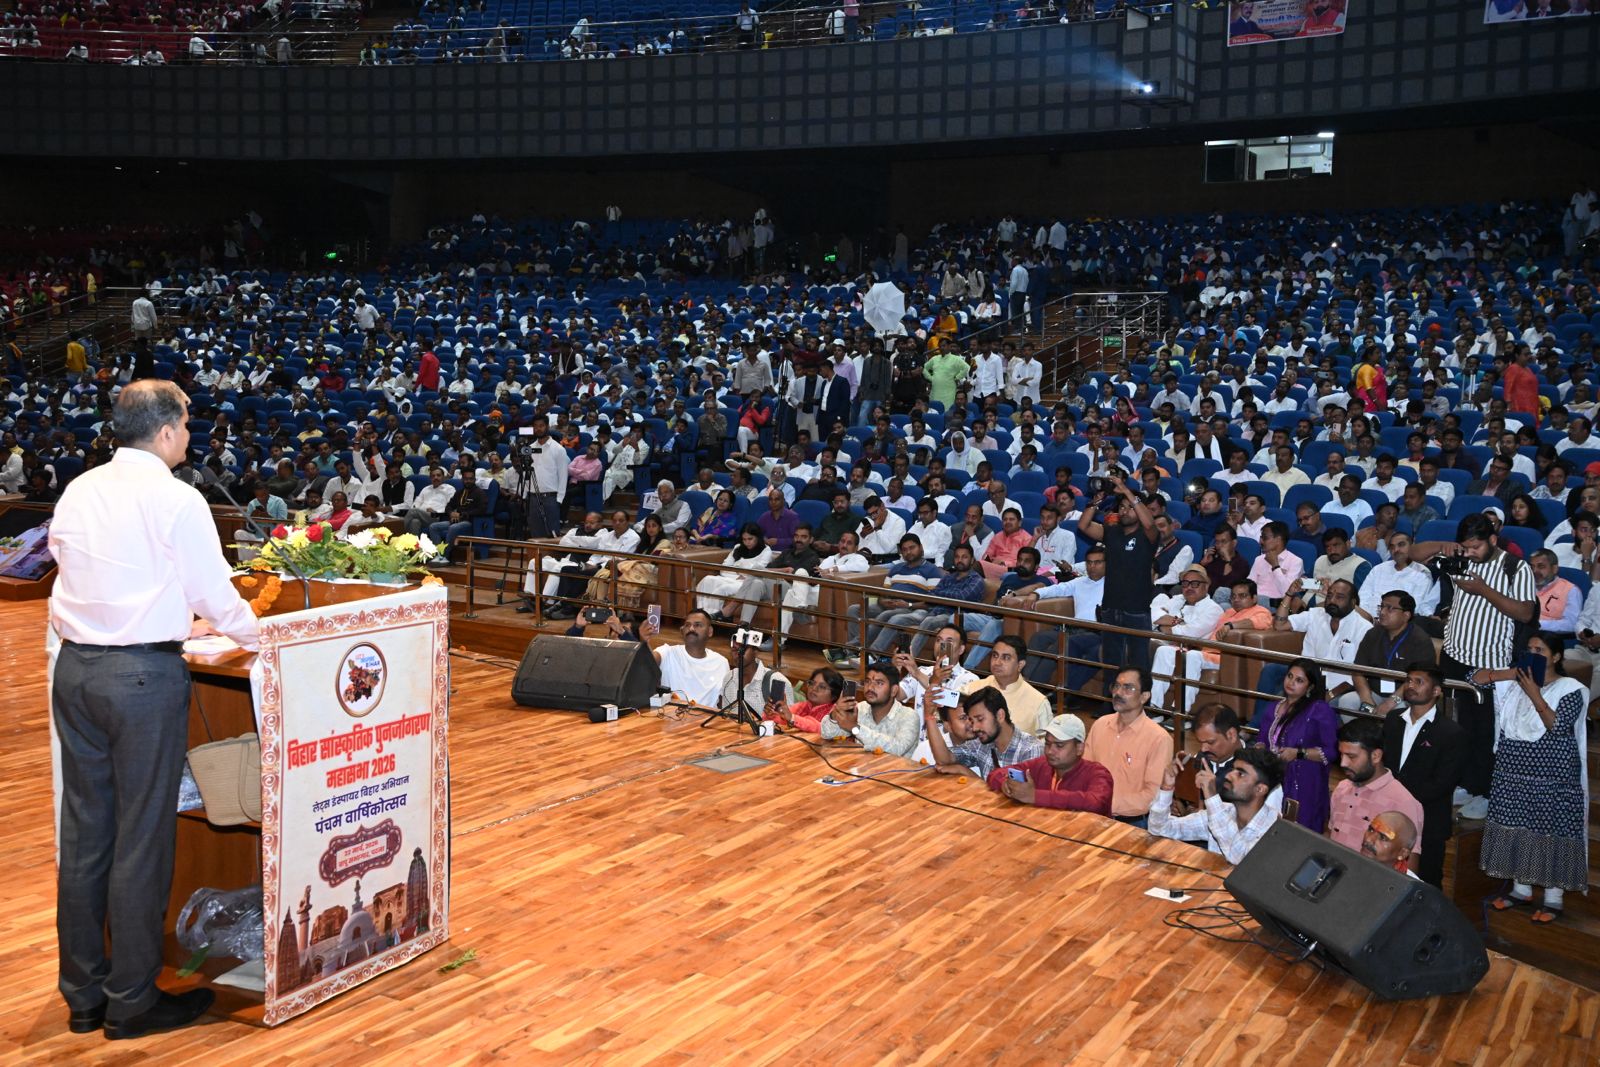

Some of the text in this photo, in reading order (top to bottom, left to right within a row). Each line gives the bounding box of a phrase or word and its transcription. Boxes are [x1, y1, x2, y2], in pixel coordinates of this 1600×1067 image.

[287, 713, 431, 770] बिहार सांस्कृतिक पुनर्जागरण
[326, 754, 396, 789] महासभा 2026
[360, 784, 380, 798] बिहार
[381, 775, 409, 791] अभियान
[315, 793, 407, 834] पंचम वार्षिकोत्सव
